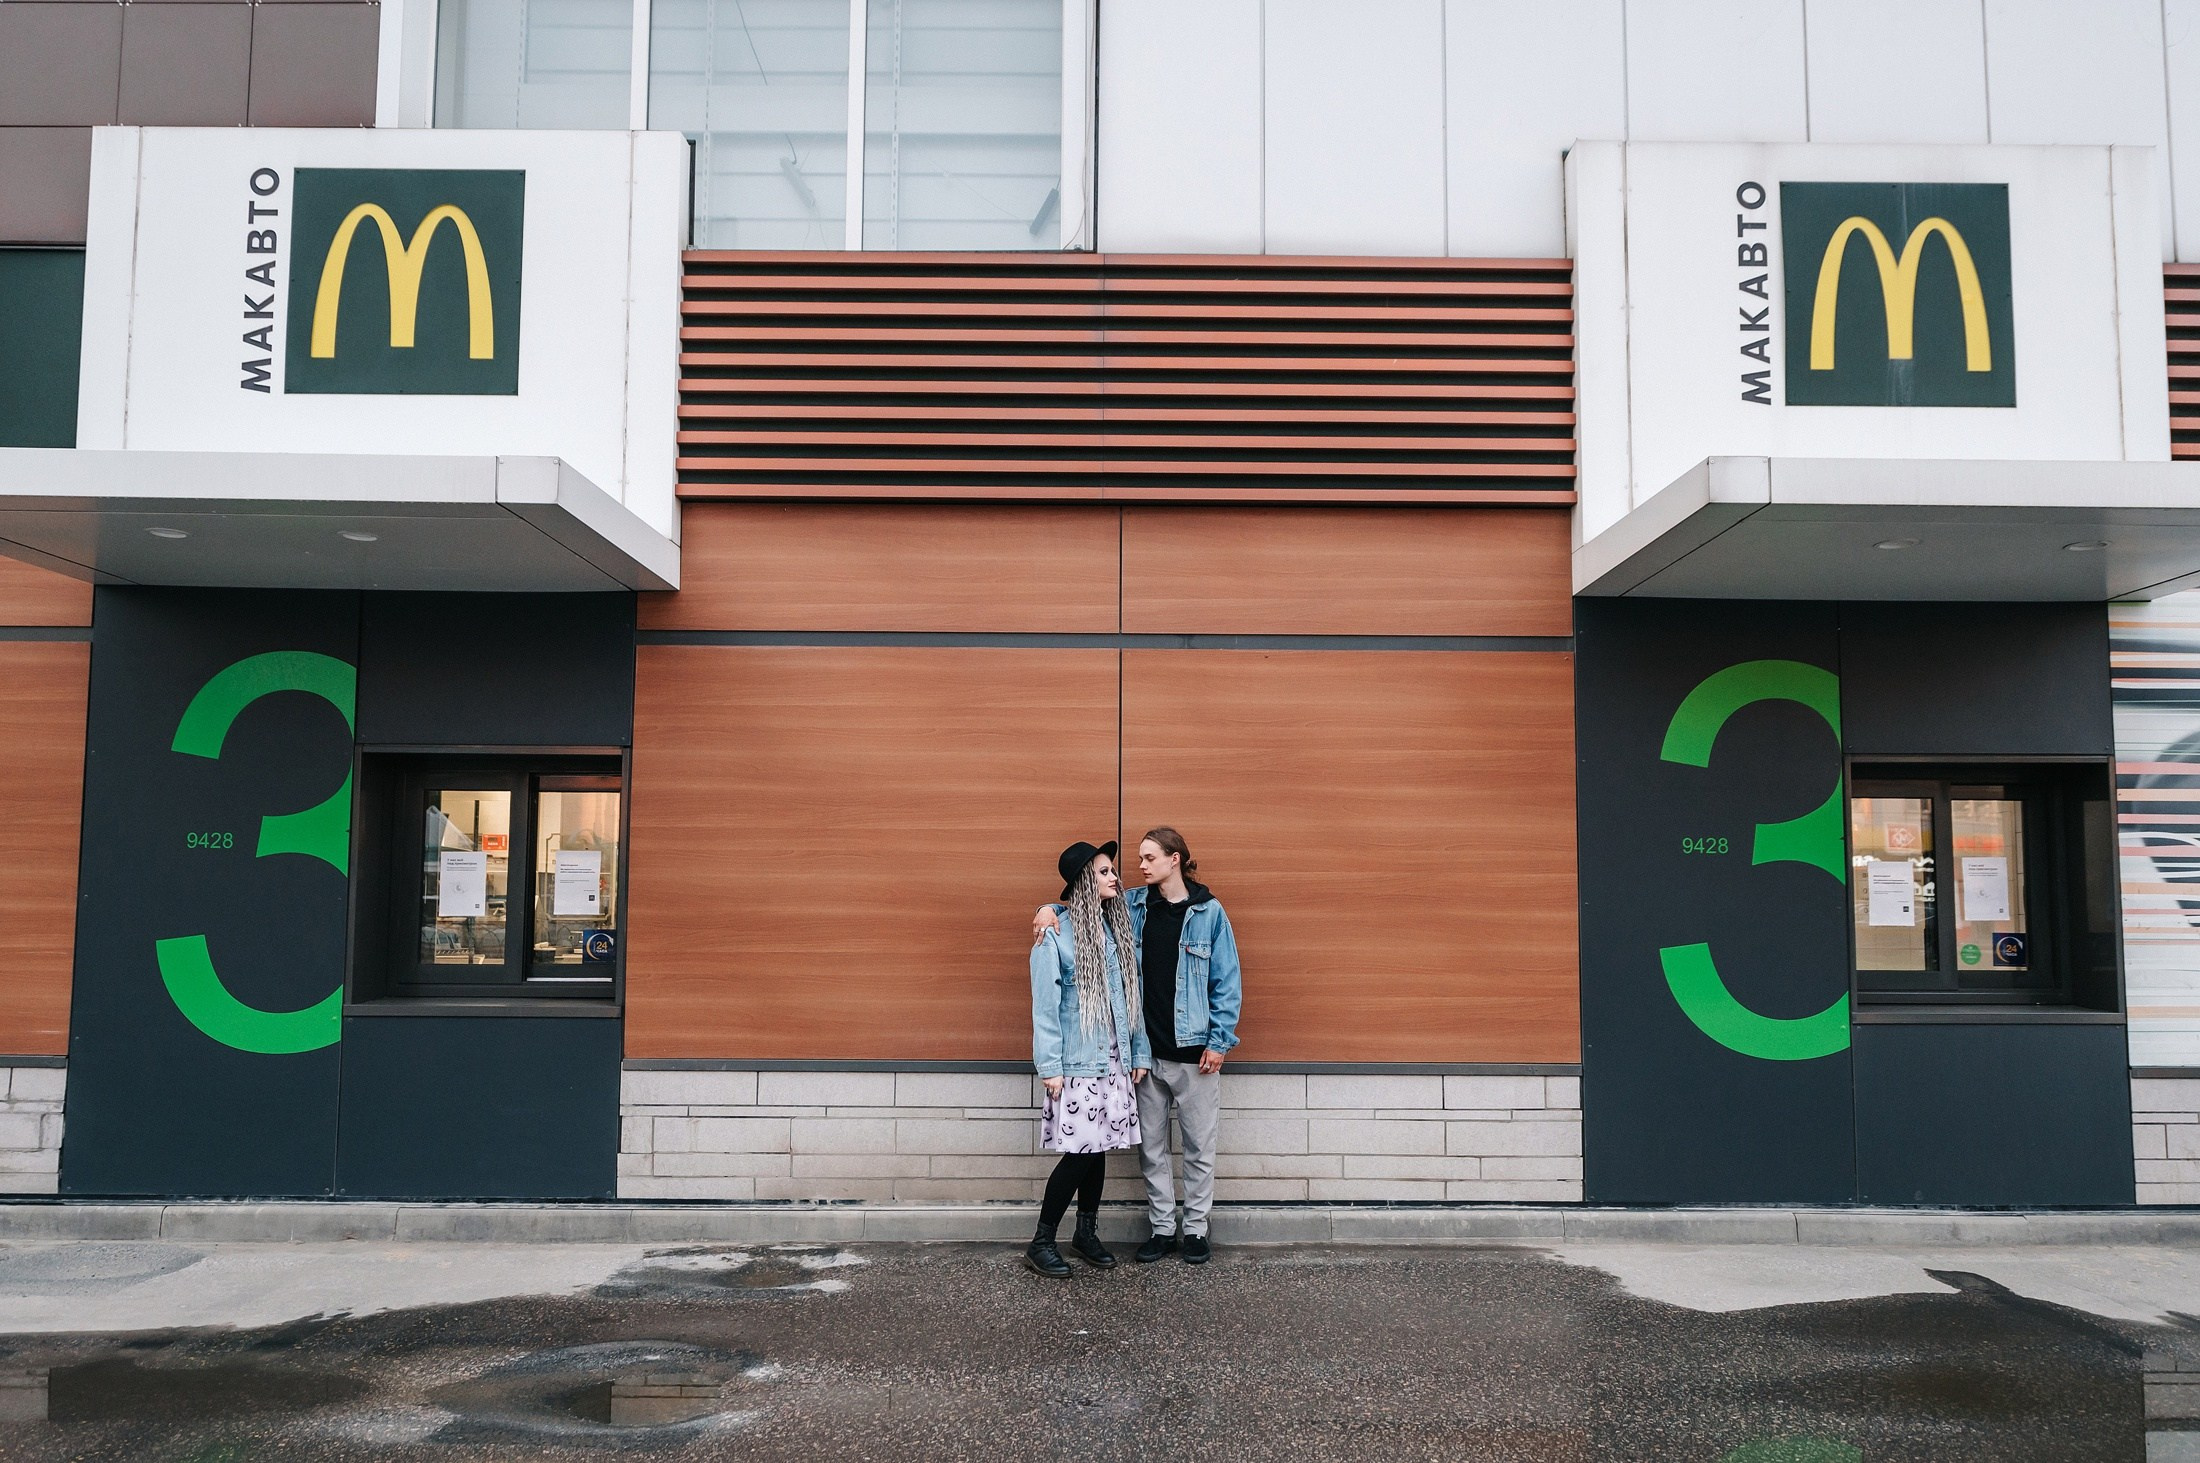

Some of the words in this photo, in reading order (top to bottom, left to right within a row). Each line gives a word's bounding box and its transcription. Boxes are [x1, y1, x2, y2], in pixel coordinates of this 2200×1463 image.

[241, 167, 280, 393] МАКАВТО
[1736, 181, 1772, 405] МАКАВТО
[156, 651, 357, 1054] 3
[186, 832, 234, 849] 9428
[1660, 660, 1851, 1060] 3
[1682, 837, 1729, 855] 9428
[596, 941, 608, 950] 24
[2006, 944, 2017, 953] 24
